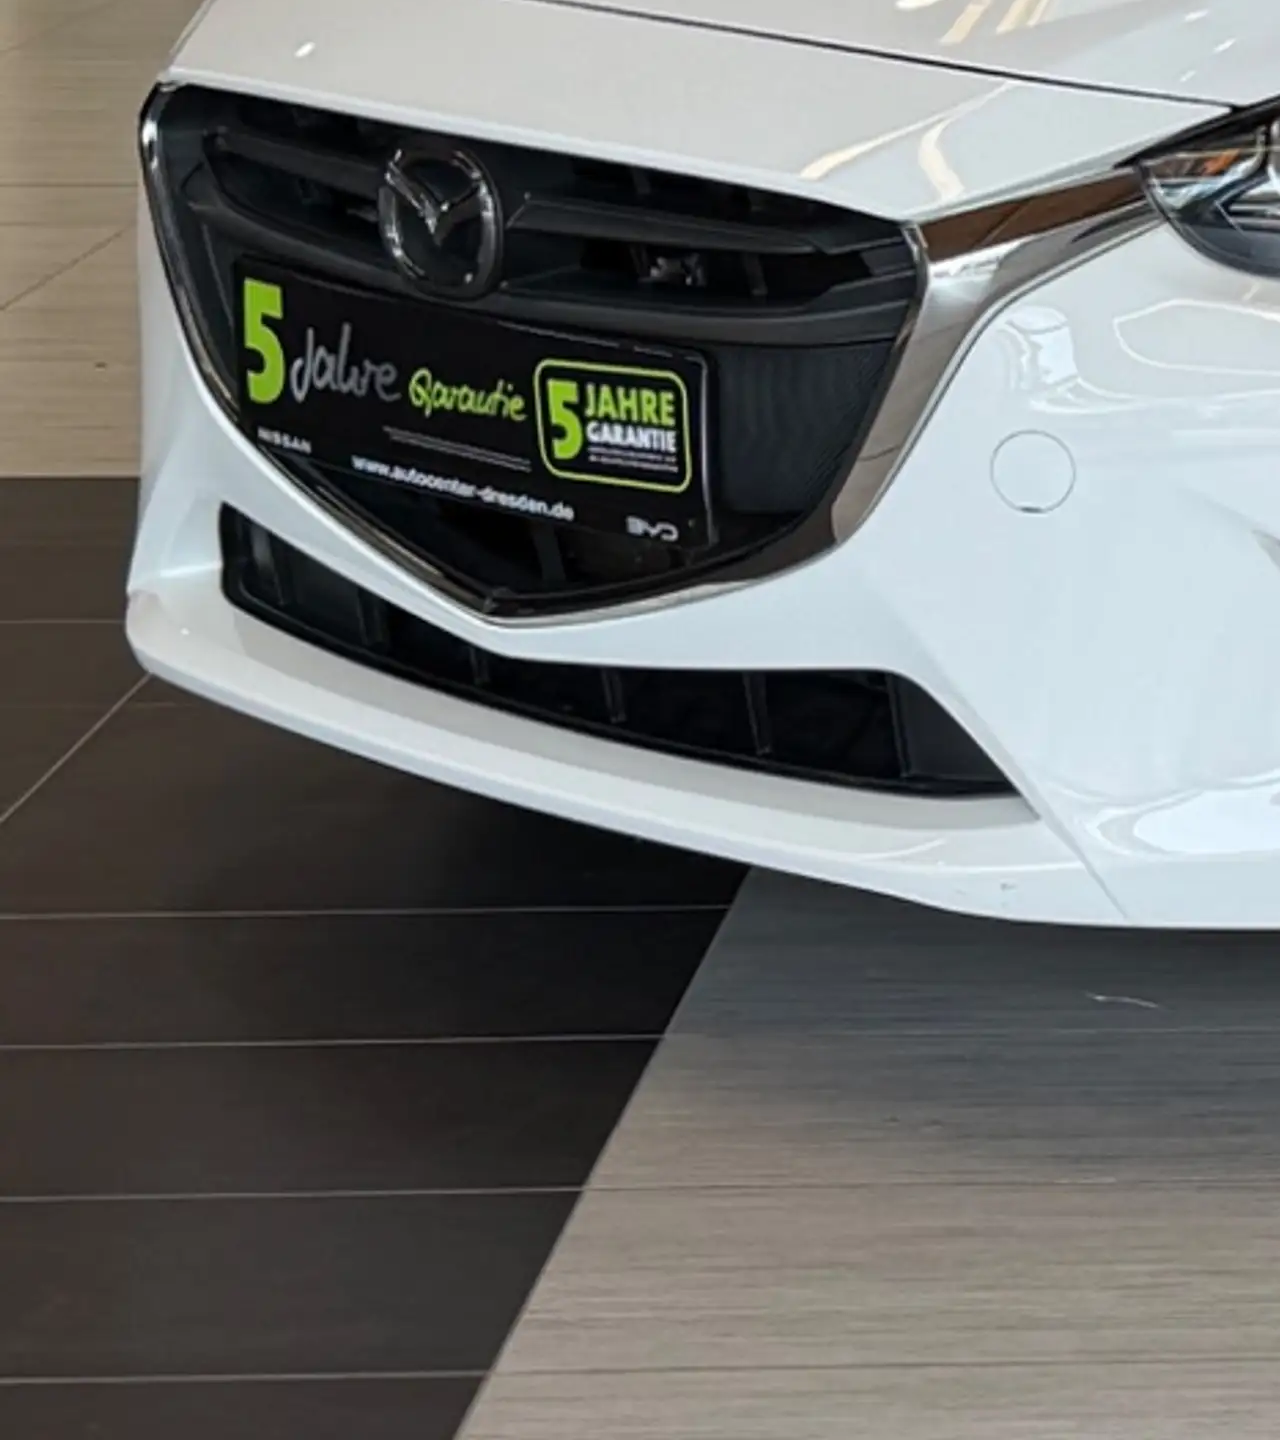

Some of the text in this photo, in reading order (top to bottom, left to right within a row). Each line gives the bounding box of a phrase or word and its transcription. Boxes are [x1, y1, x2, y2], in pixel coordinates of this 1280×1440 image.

[243, 277, 528, 422] 5 Jahre Garantie
[547, 378, 585, 460] 5
[584, 381, 677, 427] JAHRE
[585, 420, 678, 453] GARANTIE
